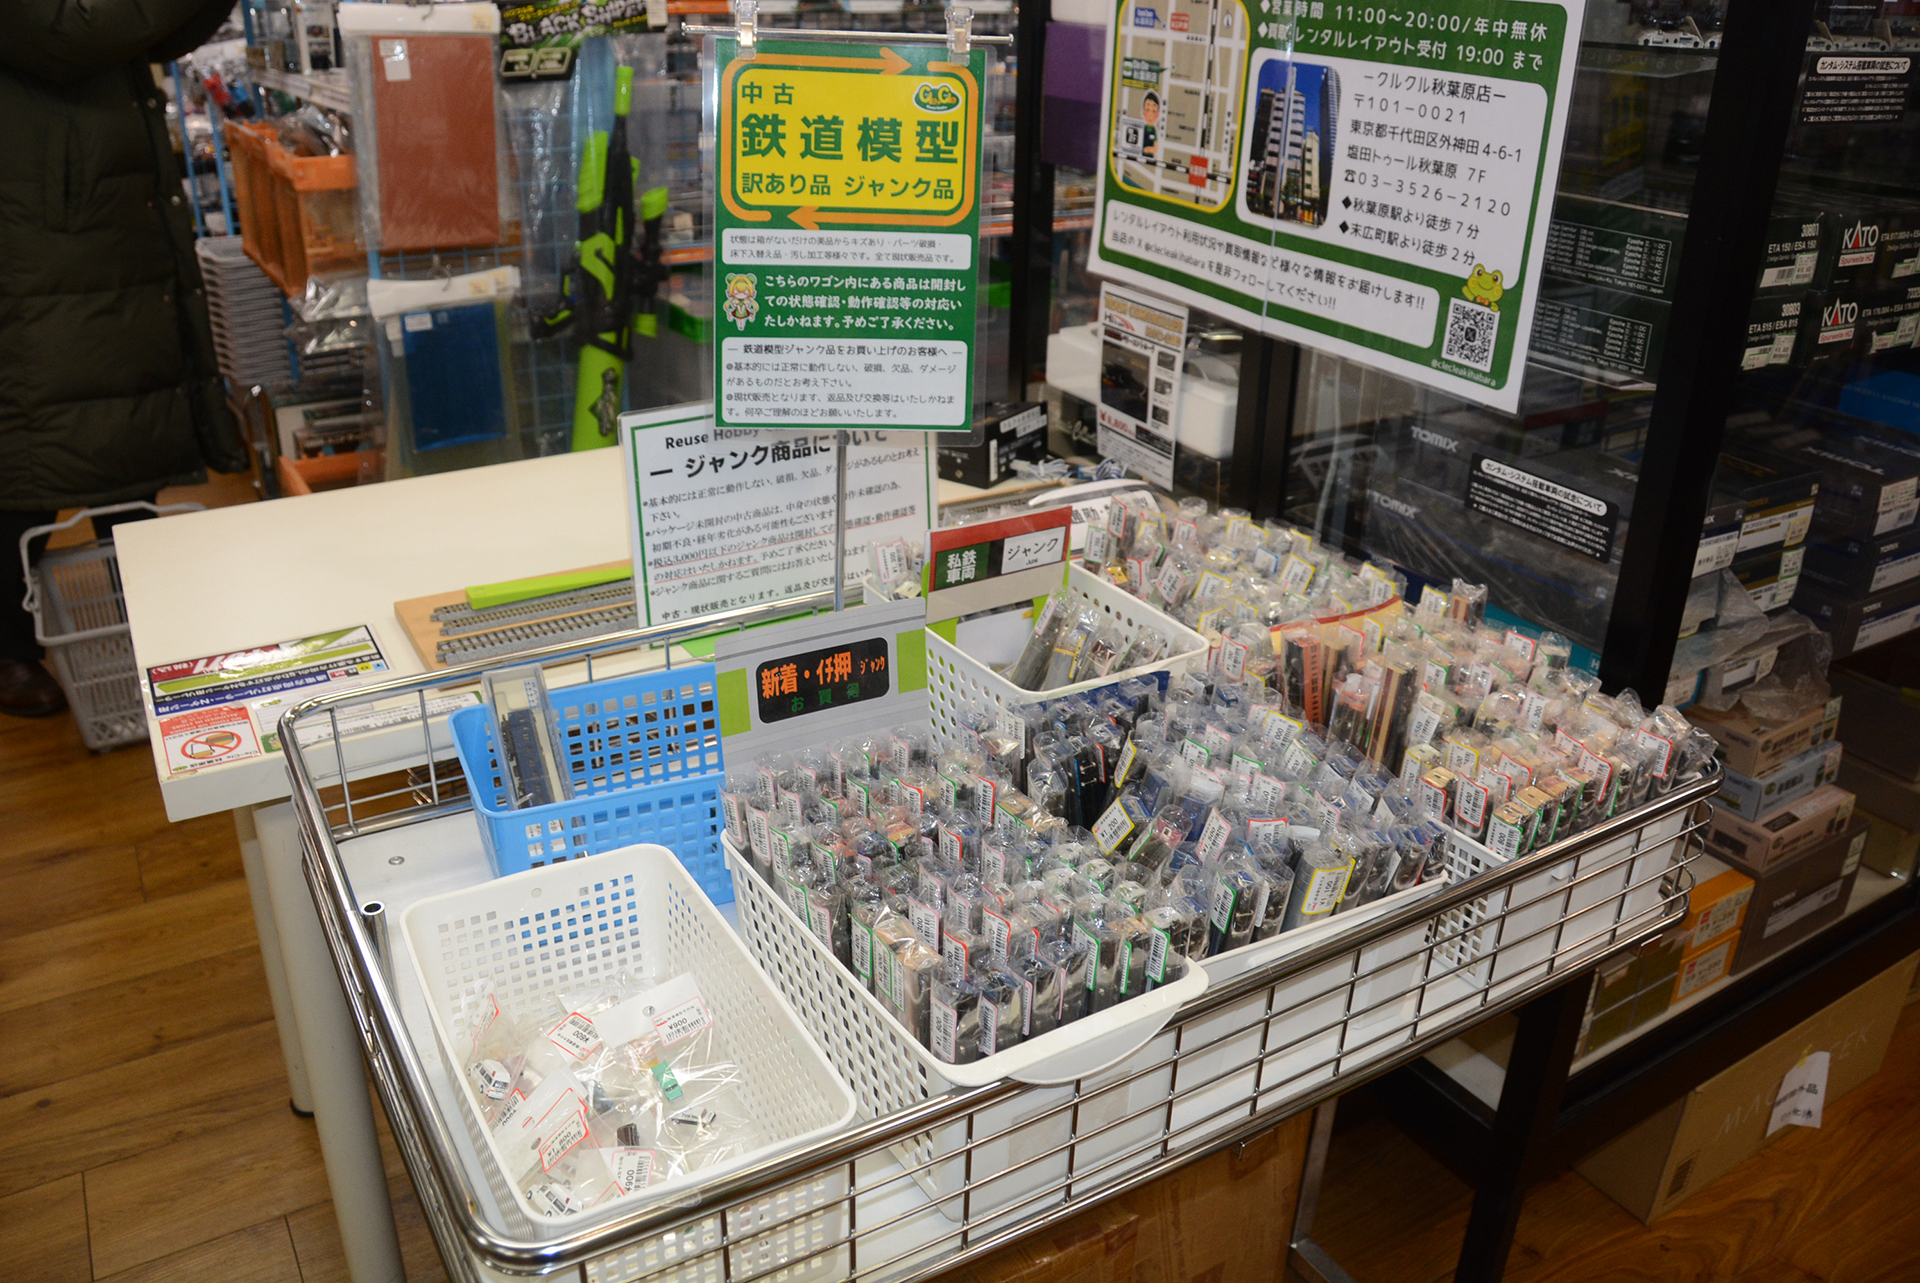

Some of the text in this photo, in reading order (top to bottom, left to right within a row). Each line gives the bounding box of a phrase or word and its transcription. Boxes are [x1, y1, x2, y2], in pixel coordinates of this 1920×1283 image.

[1456, 44, 1505, 67] 19:00
[1512, 50, 1544, 72] まで
[740, 80, 795, 105] 中古
[740, 112, 960, 164] 鉄道模型
[1346, 145, 1487, 184] 塩田トゥール秋葉原 7F
[741, 172, 955, 200] 訳あり品 ジャンク品
[1841, 220, 1880, 250] KATO
[764, 274, 967, 292] こちらのワゴン内にある商品は開封し
[764, 293, 963, 311] ての状態確認・動作確認等の対応い
[1821, 298, 1859, 328] KATO
[764, 313, 955, 331] たしかねます。予めご了承ください。
[726, 377, 853, 388] があるものだとお考え下さい。
[1431, 358, 1497, 387] @clecleakihabara
[726, 407, 898, 419] す。何卒ご理解のほどお願いいたします。
[665, 434, 709, 450] Reuse
[1410, 425, 1461, 453] TOMIX
[685, 430, 888, 479] ジャンク商品にいて
[651, 511, 681, 524] 下さい。
[946, 549, 977, 570] 私鉄
[1007, 538, 1059, 561] ジャンク
[945, 564, 976, 584] 車両
[790, 682, 860, 712] お買得
[667, 1017, 688, 1030] ¥900
